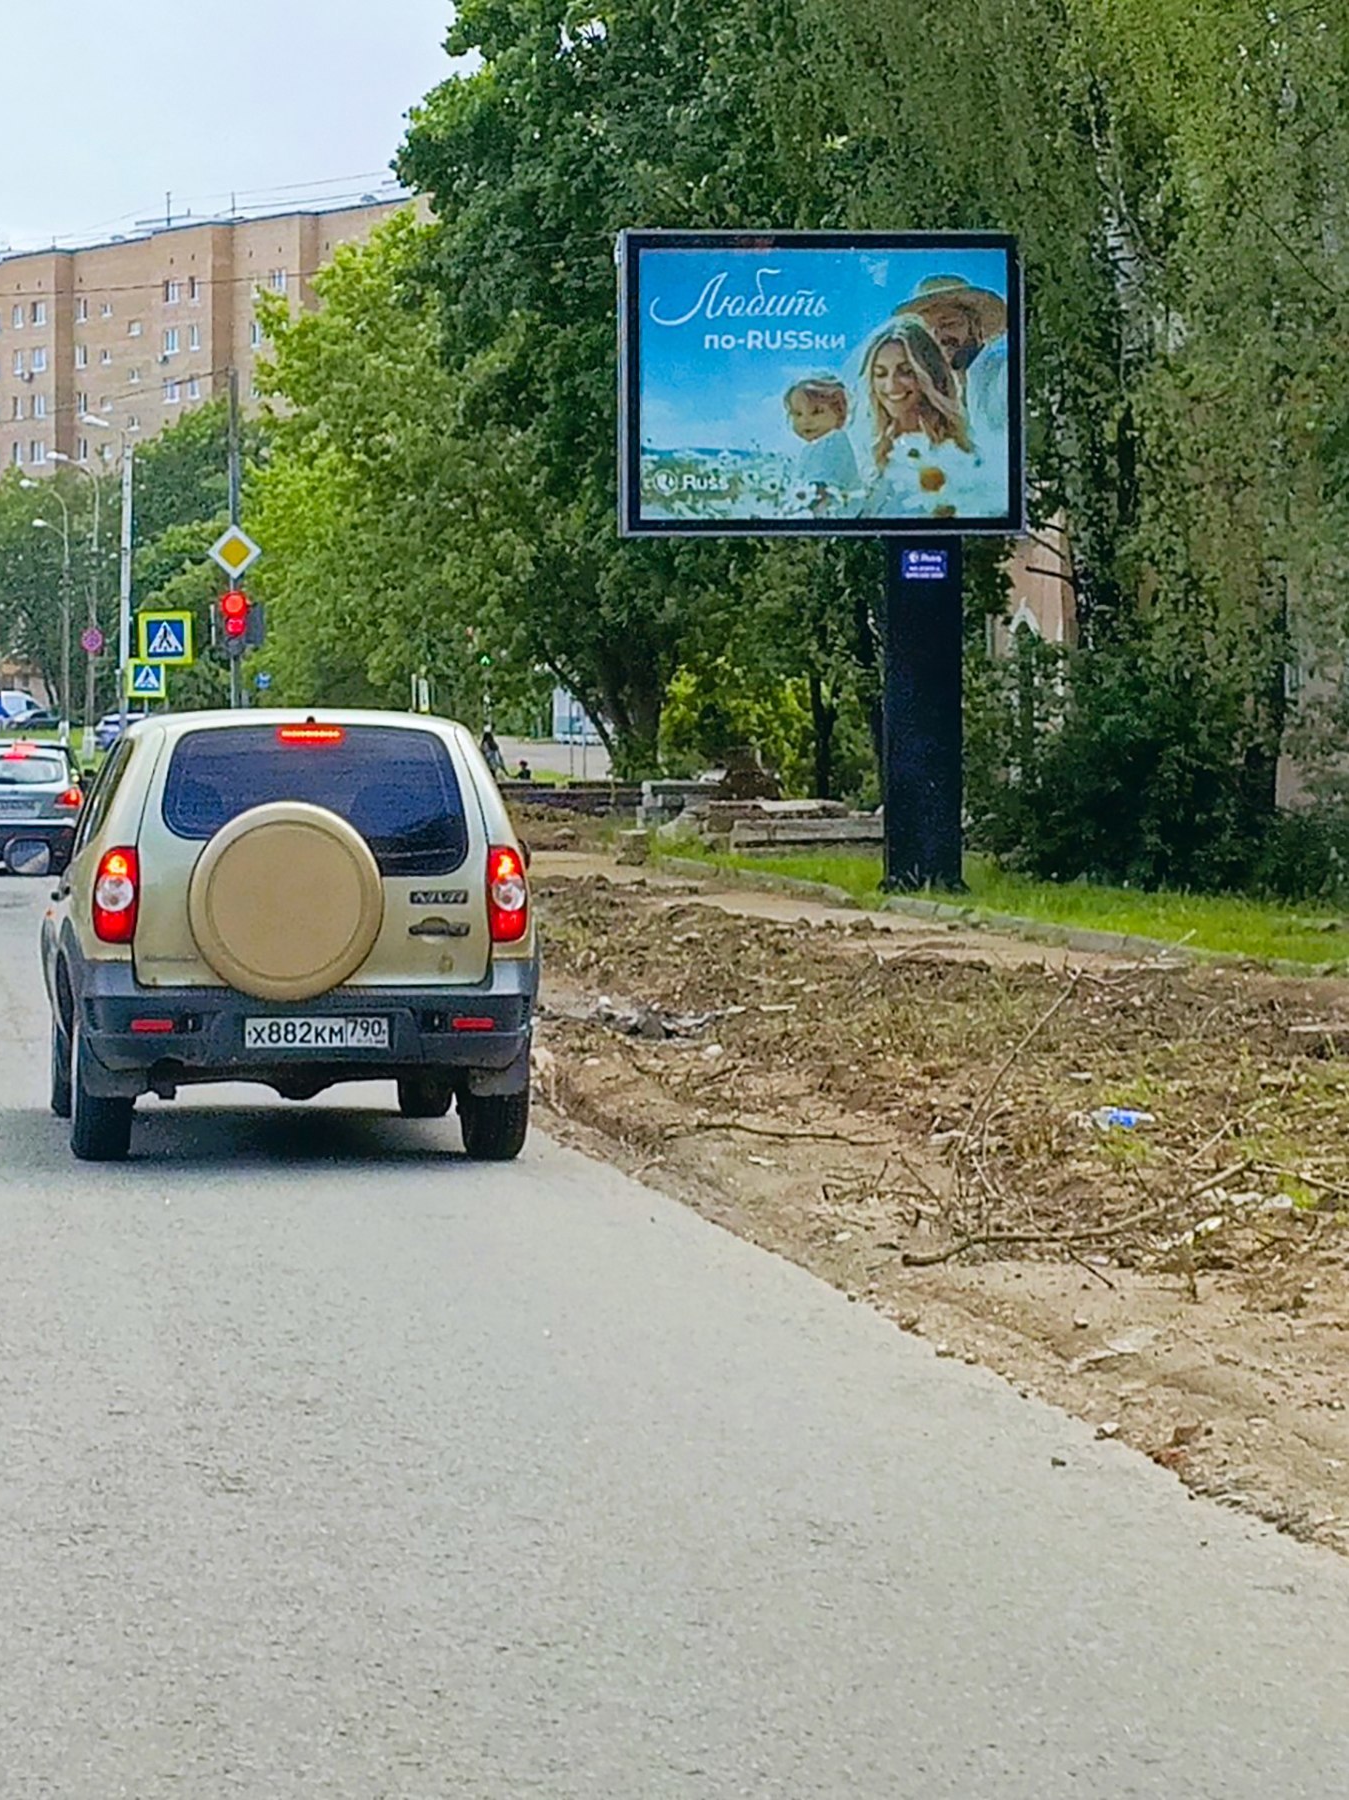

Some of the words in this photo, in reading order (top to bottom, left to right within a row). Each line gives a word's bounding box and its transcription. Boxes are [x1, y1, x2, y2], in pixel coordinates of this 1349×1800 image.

[649, 267, 829, 326] Любить
[703, 329, 847, 350] по-RUSSки
[348, 1018, 383, 1037] 790
